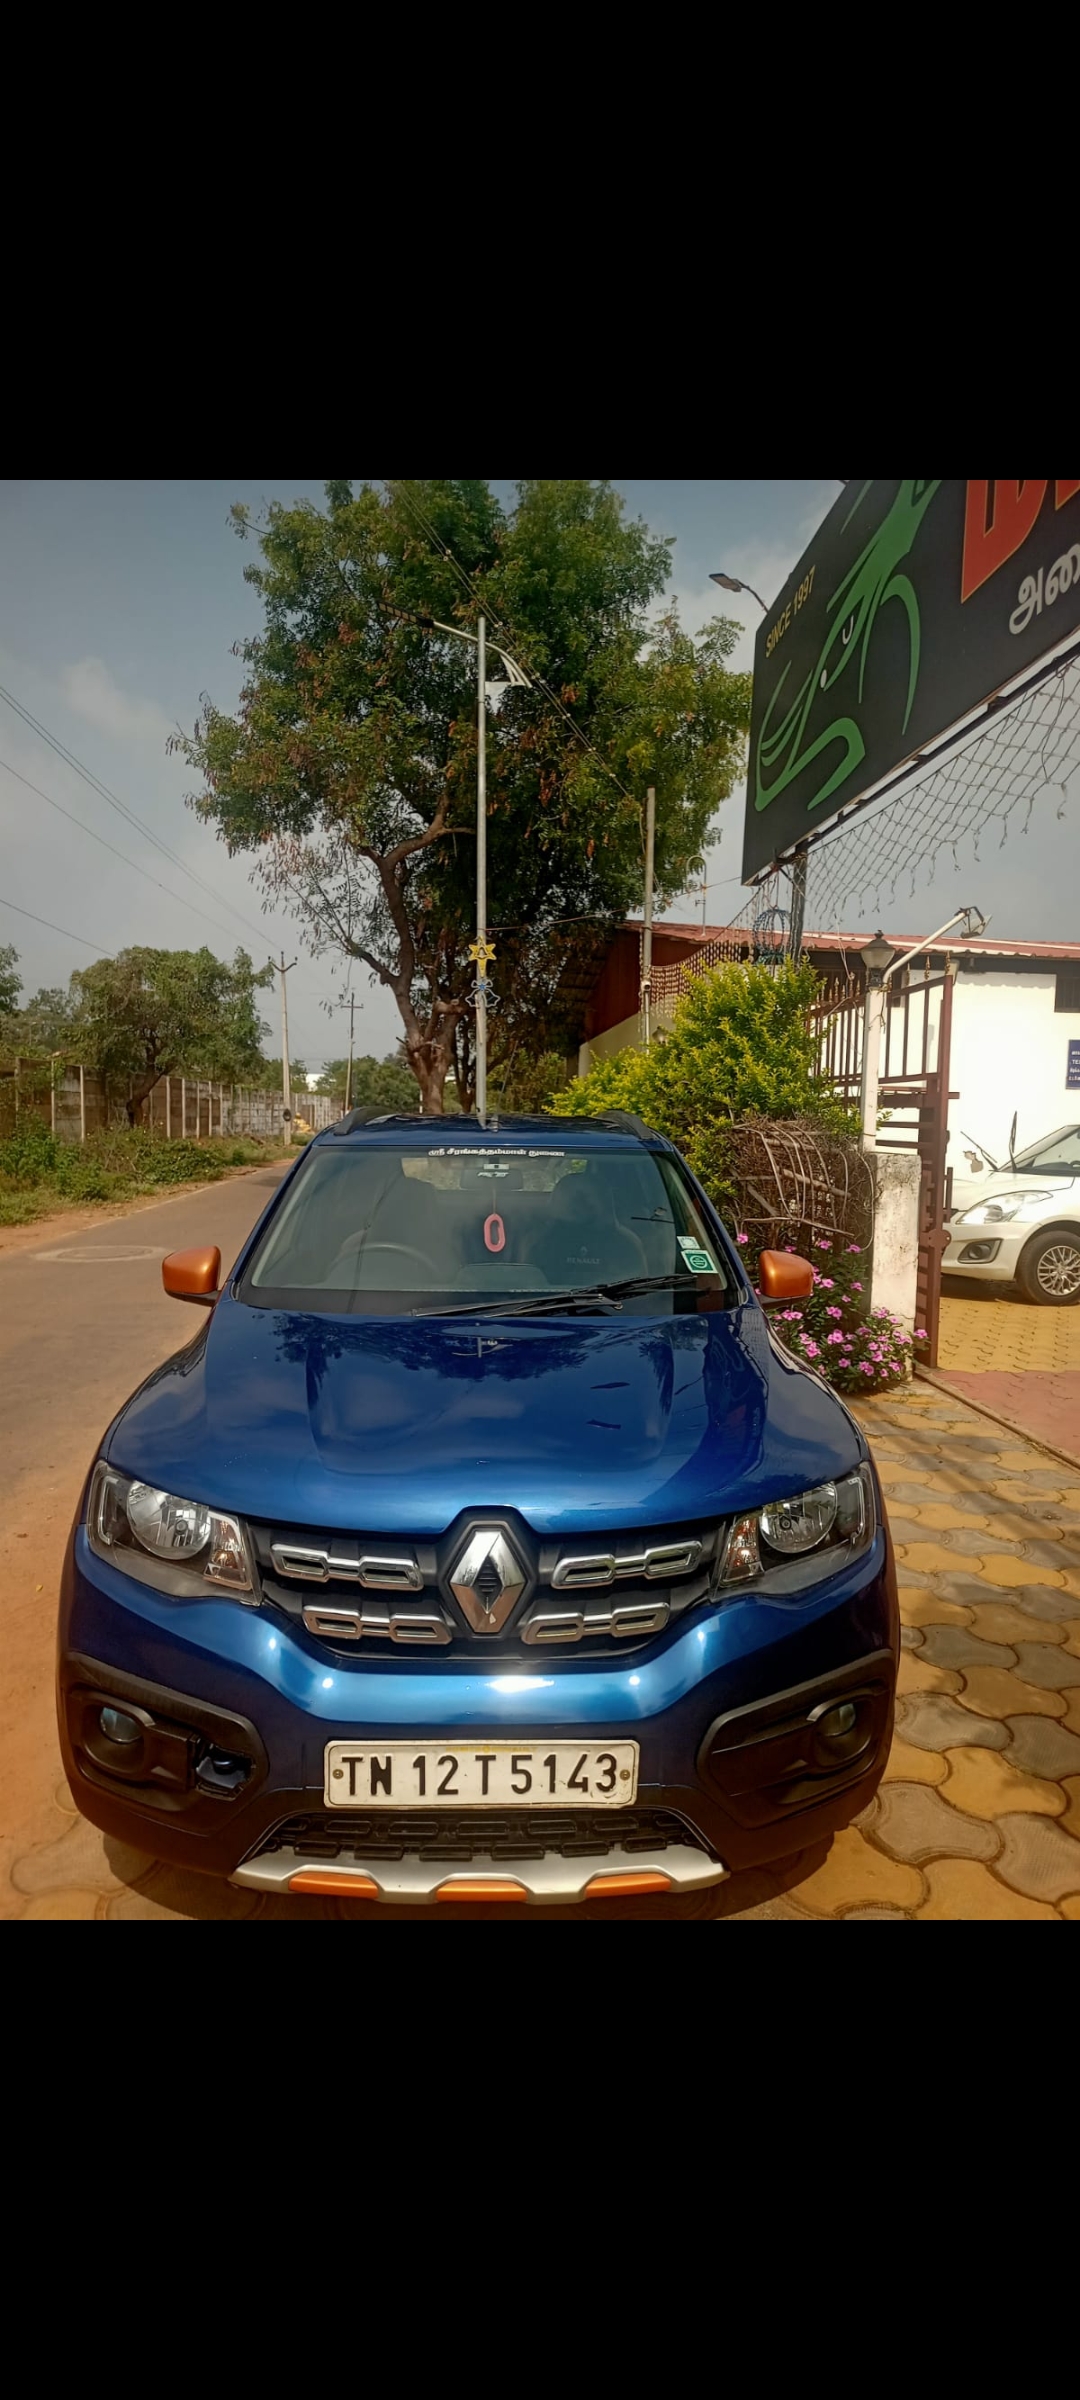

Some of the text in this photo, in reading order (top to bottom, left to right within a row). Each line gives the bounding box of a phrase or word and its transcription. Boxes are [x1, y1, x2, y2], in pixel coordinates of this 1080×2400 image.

[765, 564, 816, 658] SINCE 1997
[341, 1753, 618, 1796] TN 12 T 5143
